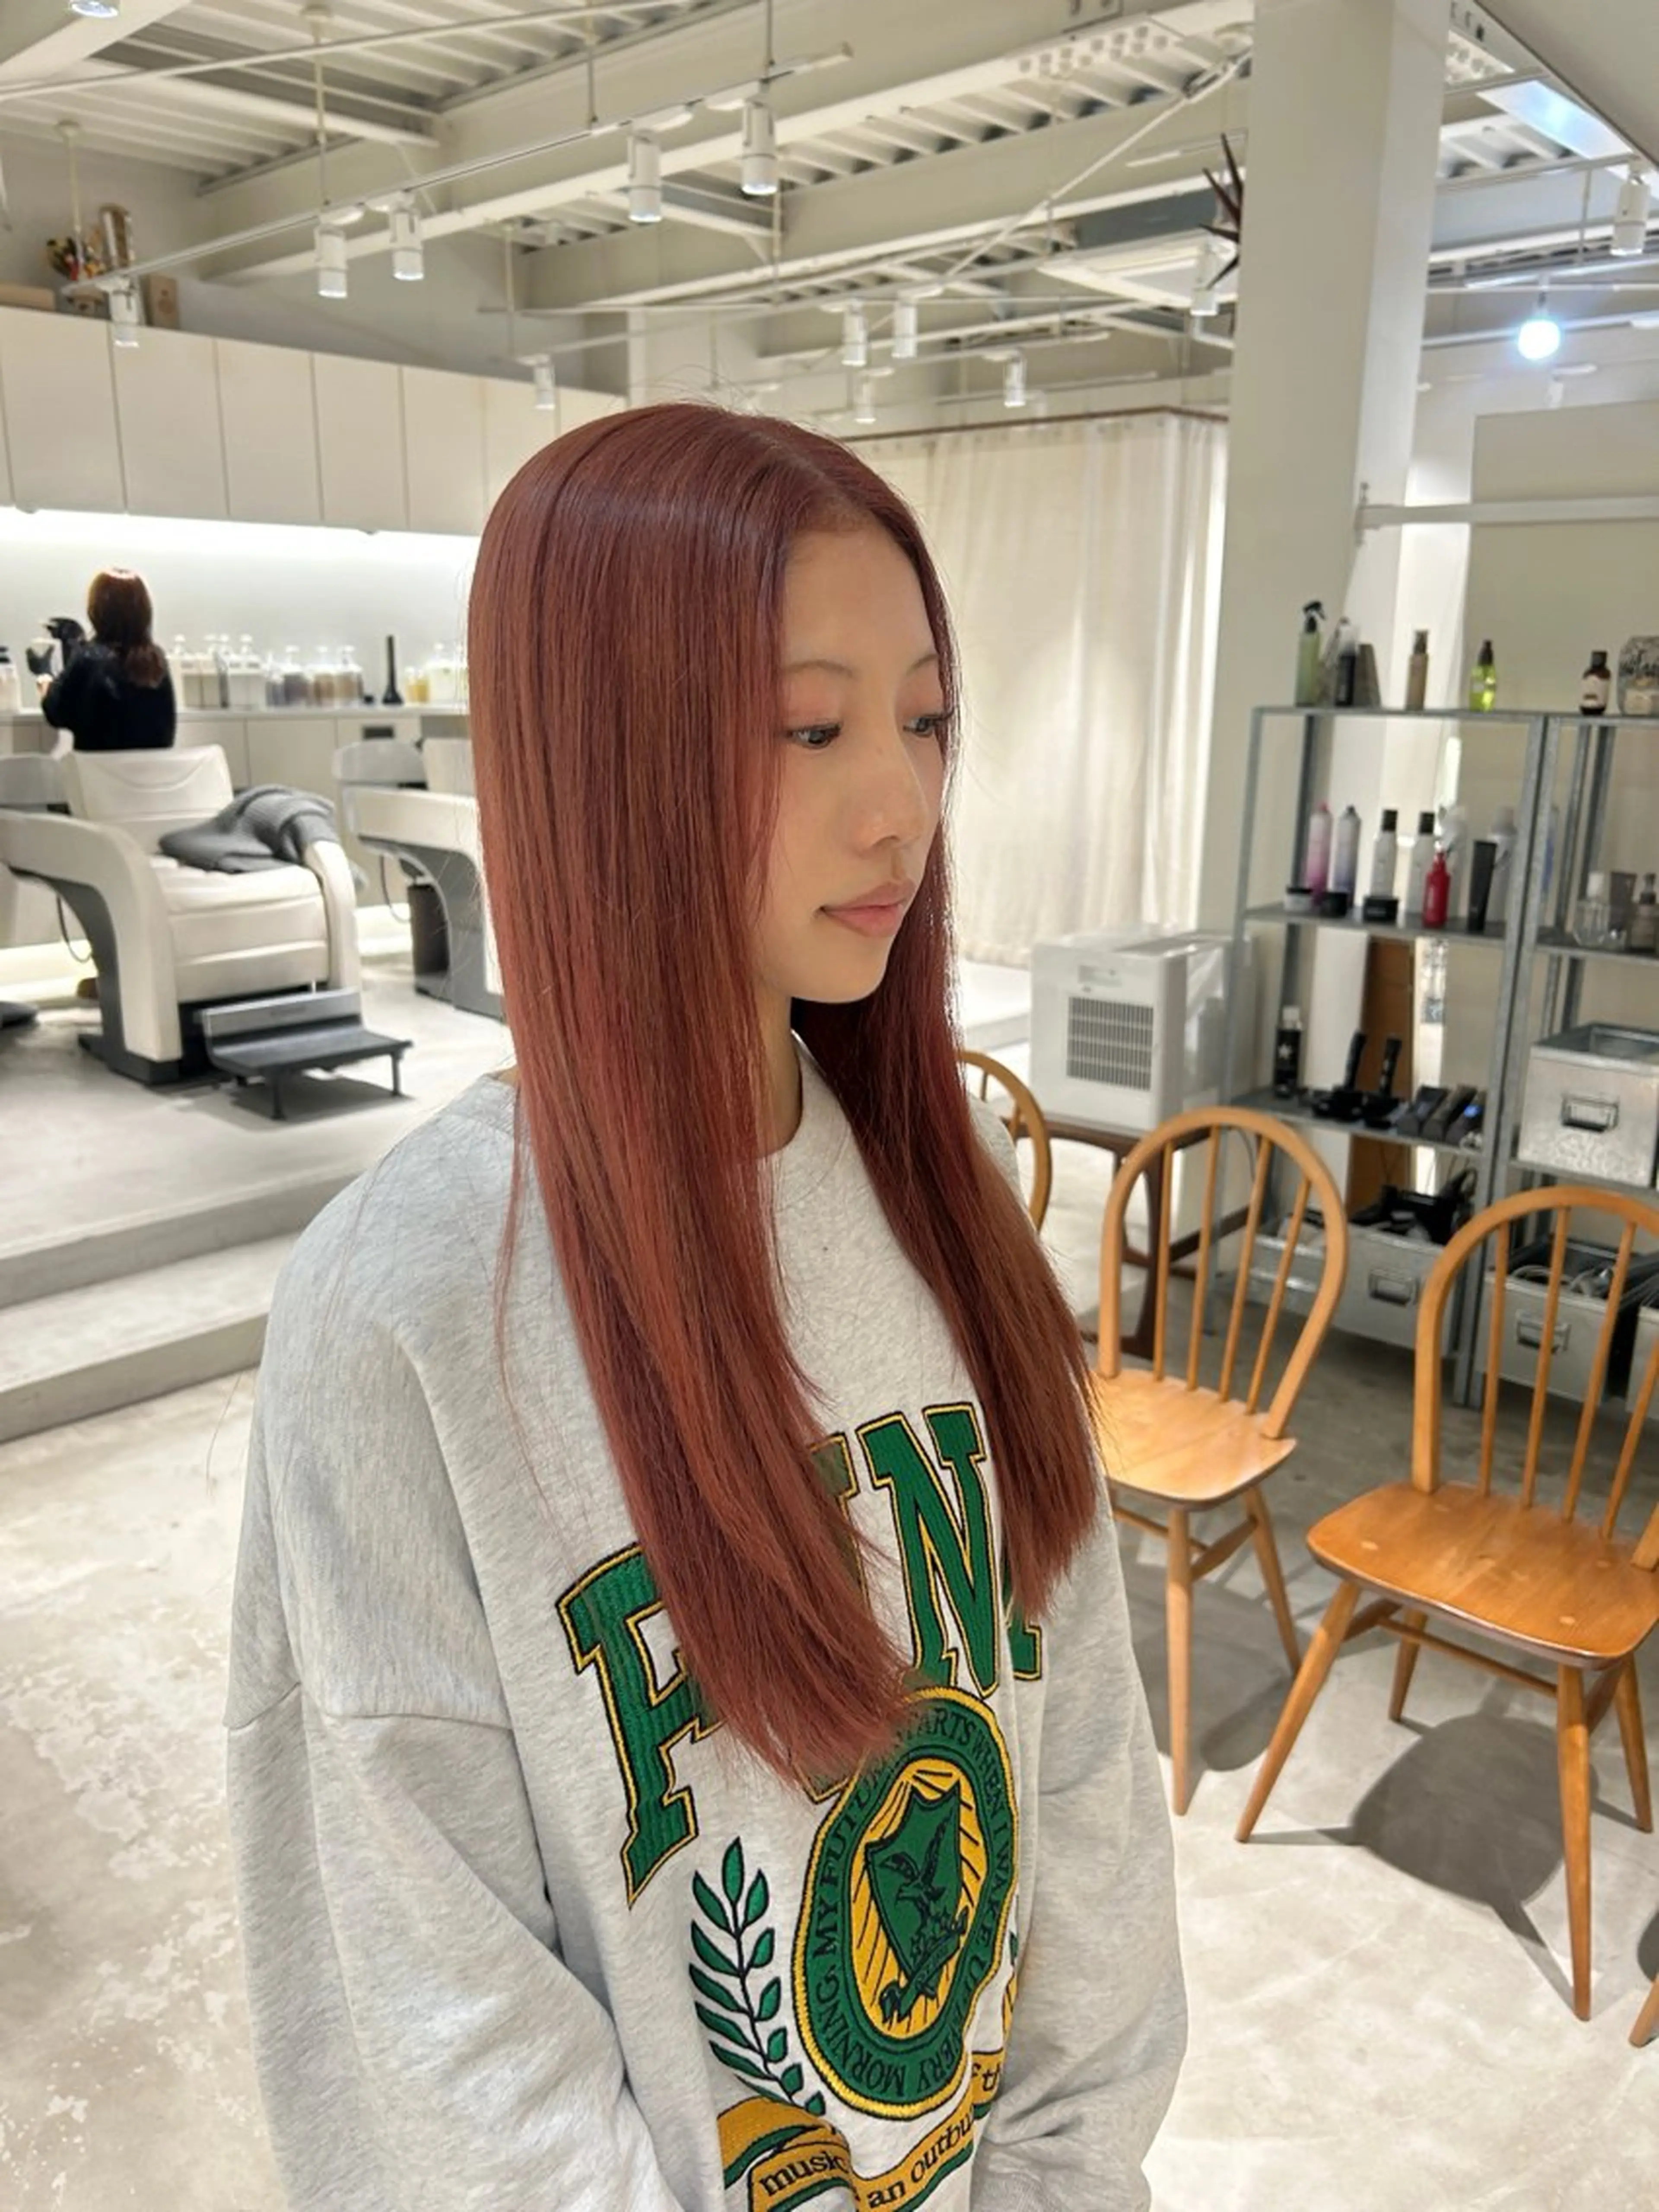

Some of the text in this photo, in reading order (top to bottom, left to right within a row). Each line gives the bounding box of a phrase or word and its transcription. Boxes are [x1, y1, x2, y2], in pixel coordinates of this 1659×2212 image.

[814, 1897, 838, 1958] MY
[759, 2151, 849, 2197] music
[867, 2180, 906, 2209] an
